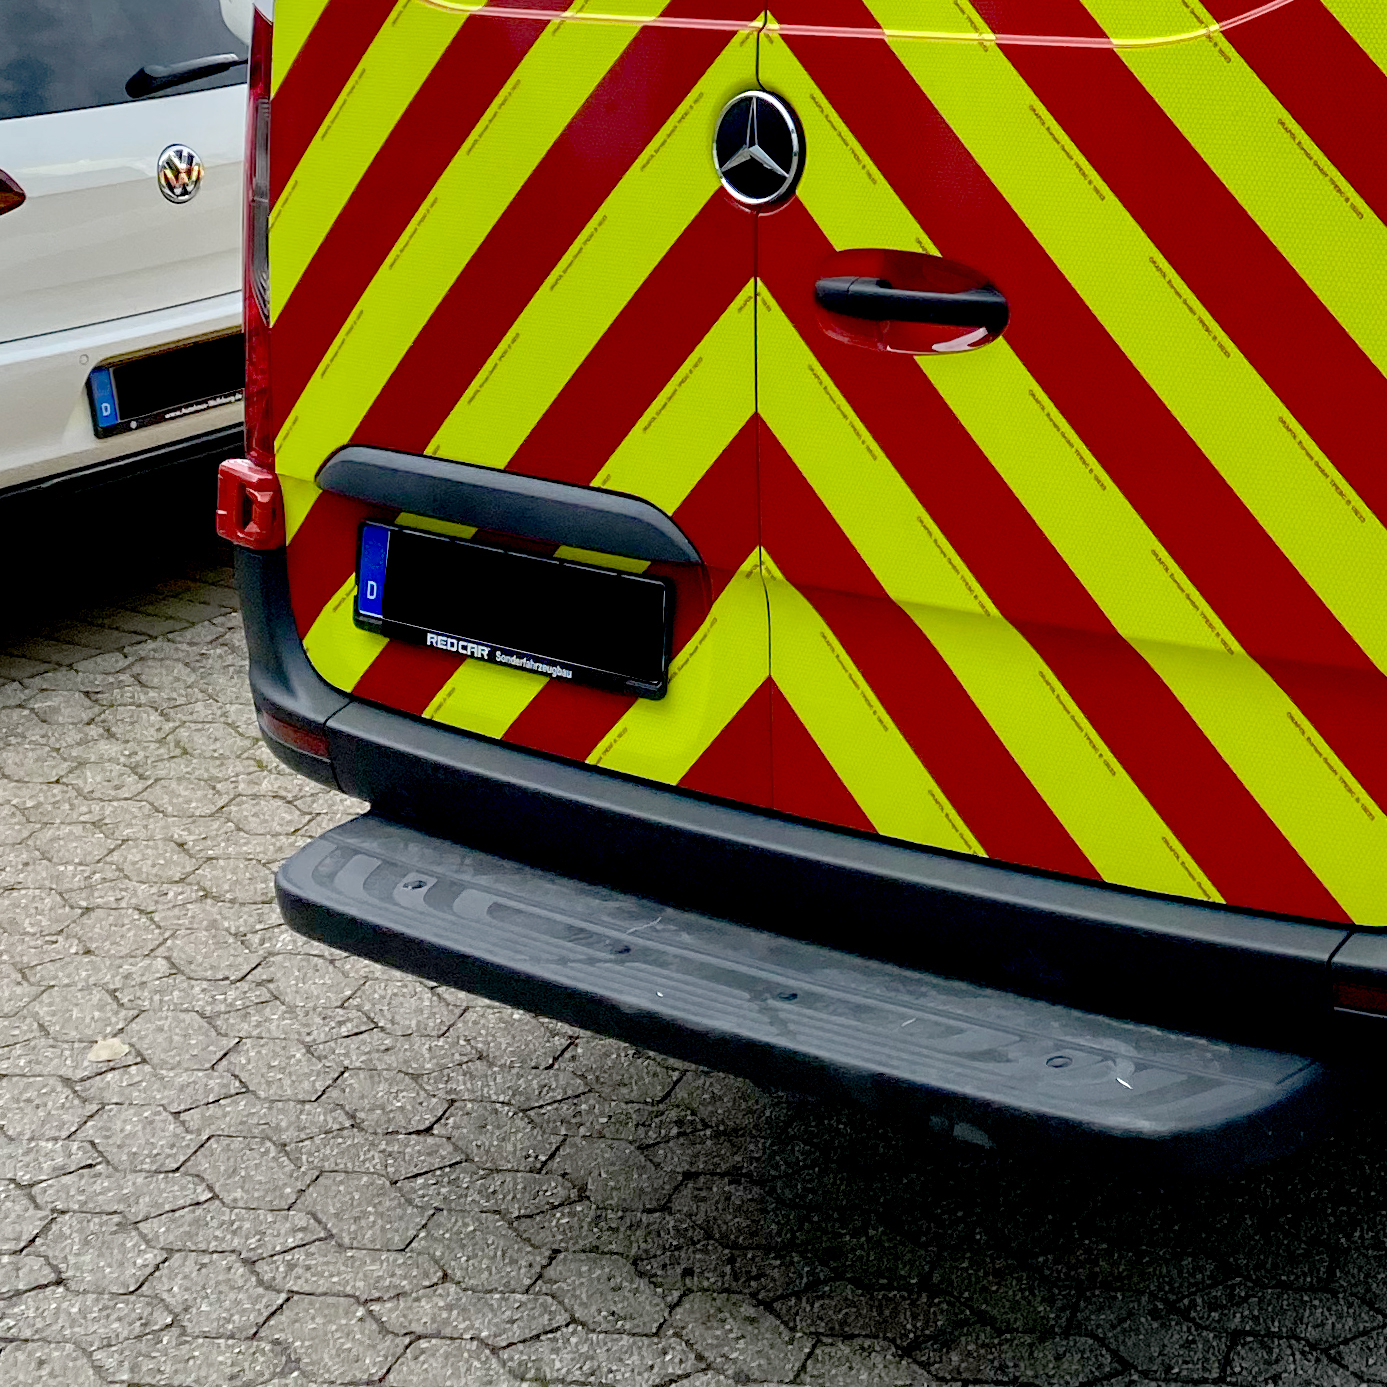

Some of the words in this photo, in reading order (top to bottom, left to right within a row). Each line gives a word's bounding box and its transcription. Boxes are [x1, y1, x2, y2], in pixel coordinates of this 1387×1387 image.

[101, 402, 111, 416] D
[366, 580, 378, 600] D
[426, 632, 491, 660] REDCAR
[495, 650, 573, 679] Sonderfahrzeugbau
